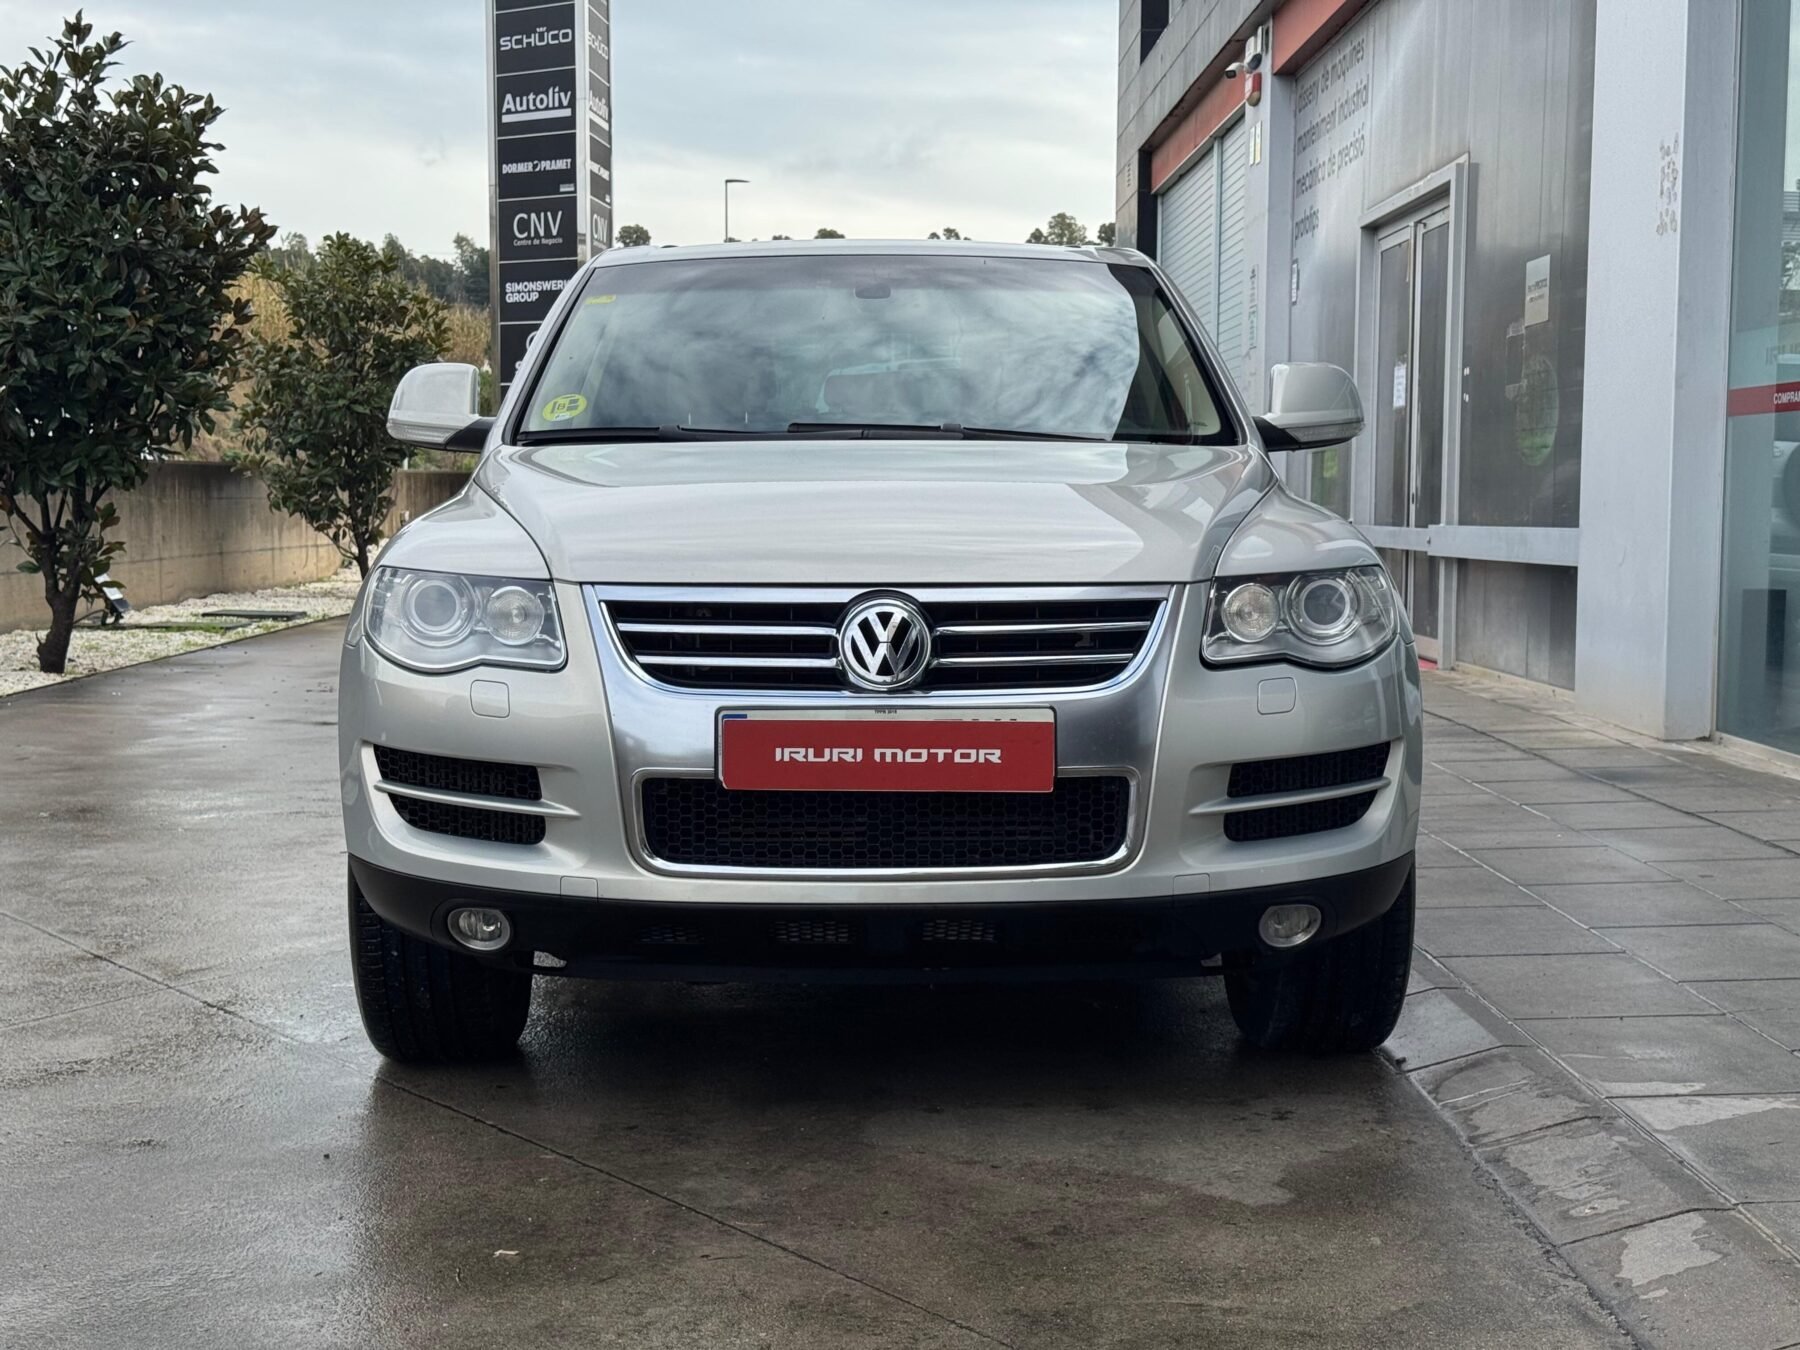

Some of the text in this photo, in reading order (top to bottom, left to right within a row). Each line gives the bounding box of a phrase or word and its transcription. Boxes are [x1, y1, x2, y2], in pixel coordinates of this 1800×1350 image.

[500, 26, 572, 51] SCHÜCO
[1320, 63, 1330, 94] de
[502, 86, 571, 113] Autoliv
[1326, 147, 1336, 179] de
[1337, 121, 1365, 180] precisió
[502, 158, 572, 175] DORMER PRAMET
[513, 210, 562, 239] CNV
[505, 292, 540, 303] GROUP
[775, 747, 1002, 763] IRURI MOTOR
